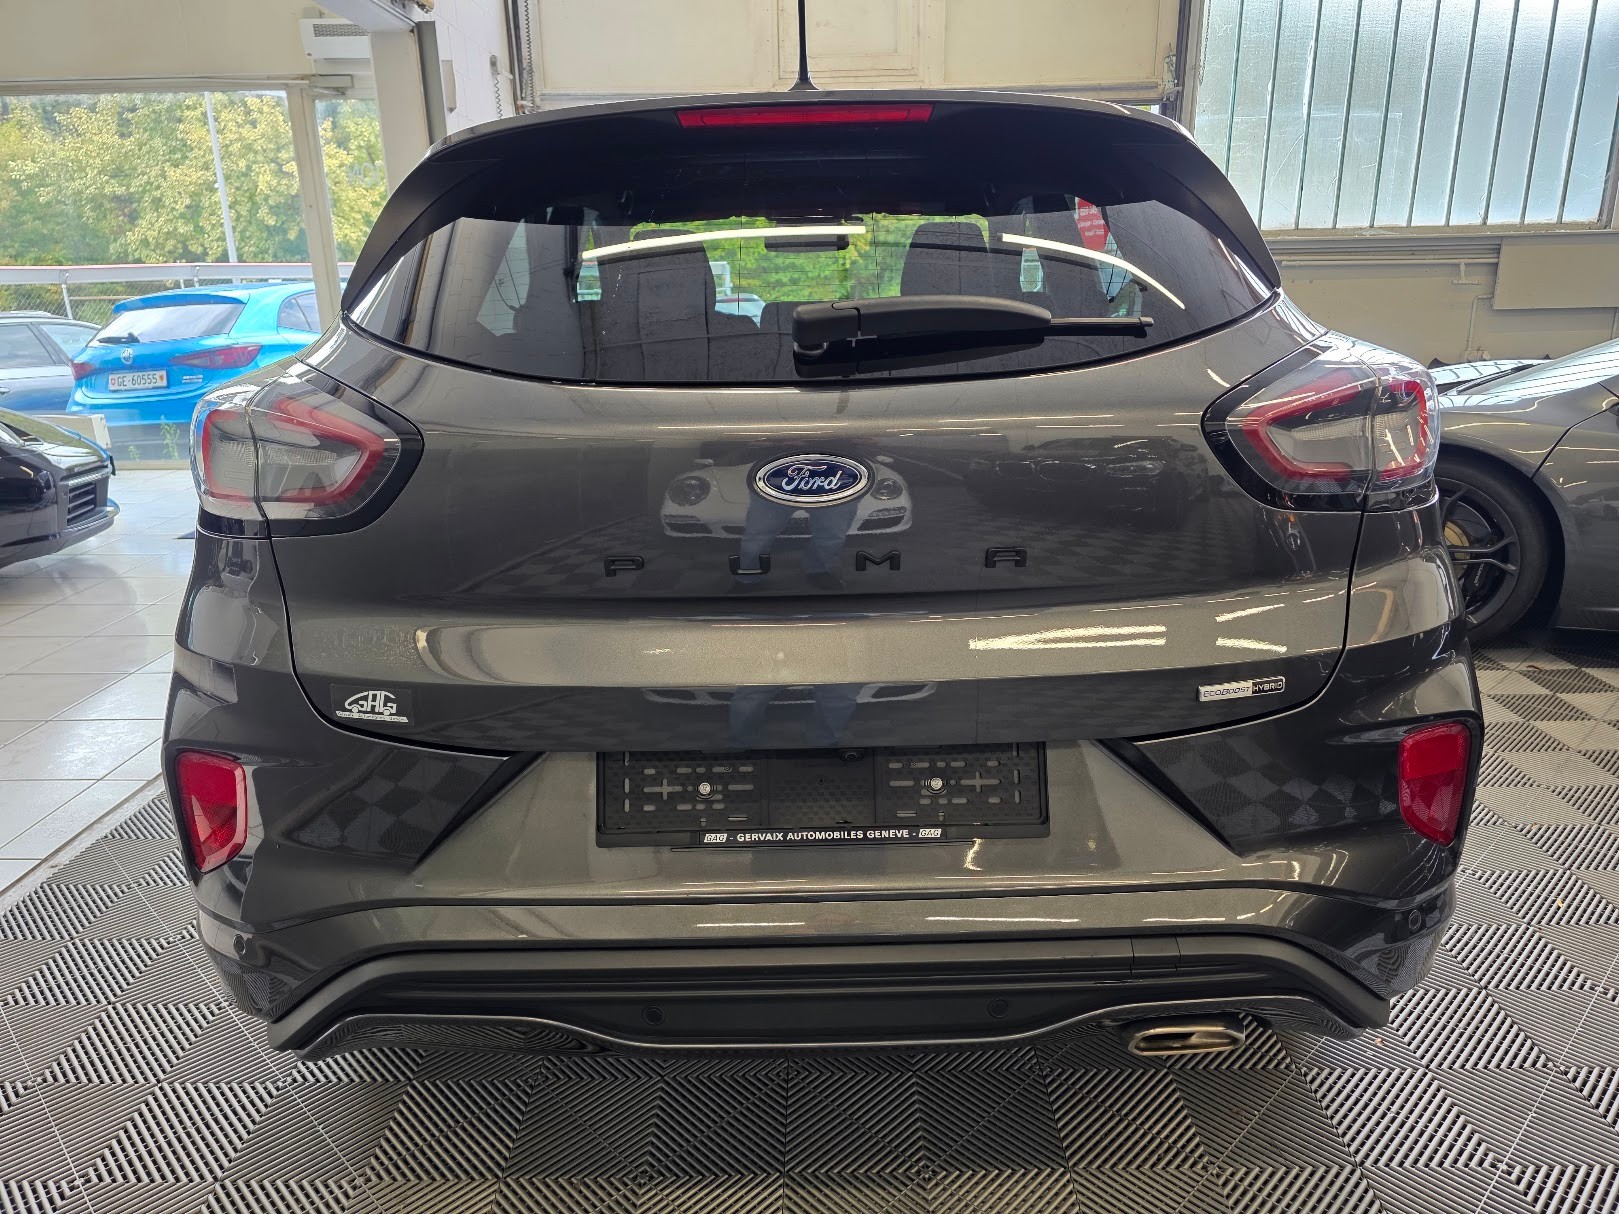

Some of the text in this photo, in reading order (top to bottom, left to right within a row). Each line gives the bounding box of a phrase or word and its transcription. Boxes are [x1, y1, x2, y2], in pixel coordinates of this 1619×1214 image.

[781, 464, 843, 491] Ford
[604, 546, 1028, 577] PUMA
[1252, 681, 1283, 692] HYBRID
[344, 690, 398, 714] GAG
[705, 834, 727, 842] GAG
[737, 832, 783, 841] GERVAIX
[786, 830, 863, 840] AUTOMOBILES
[866, 829, 909, 838] GENEVE
[919, 829, 941, 837] GAG
